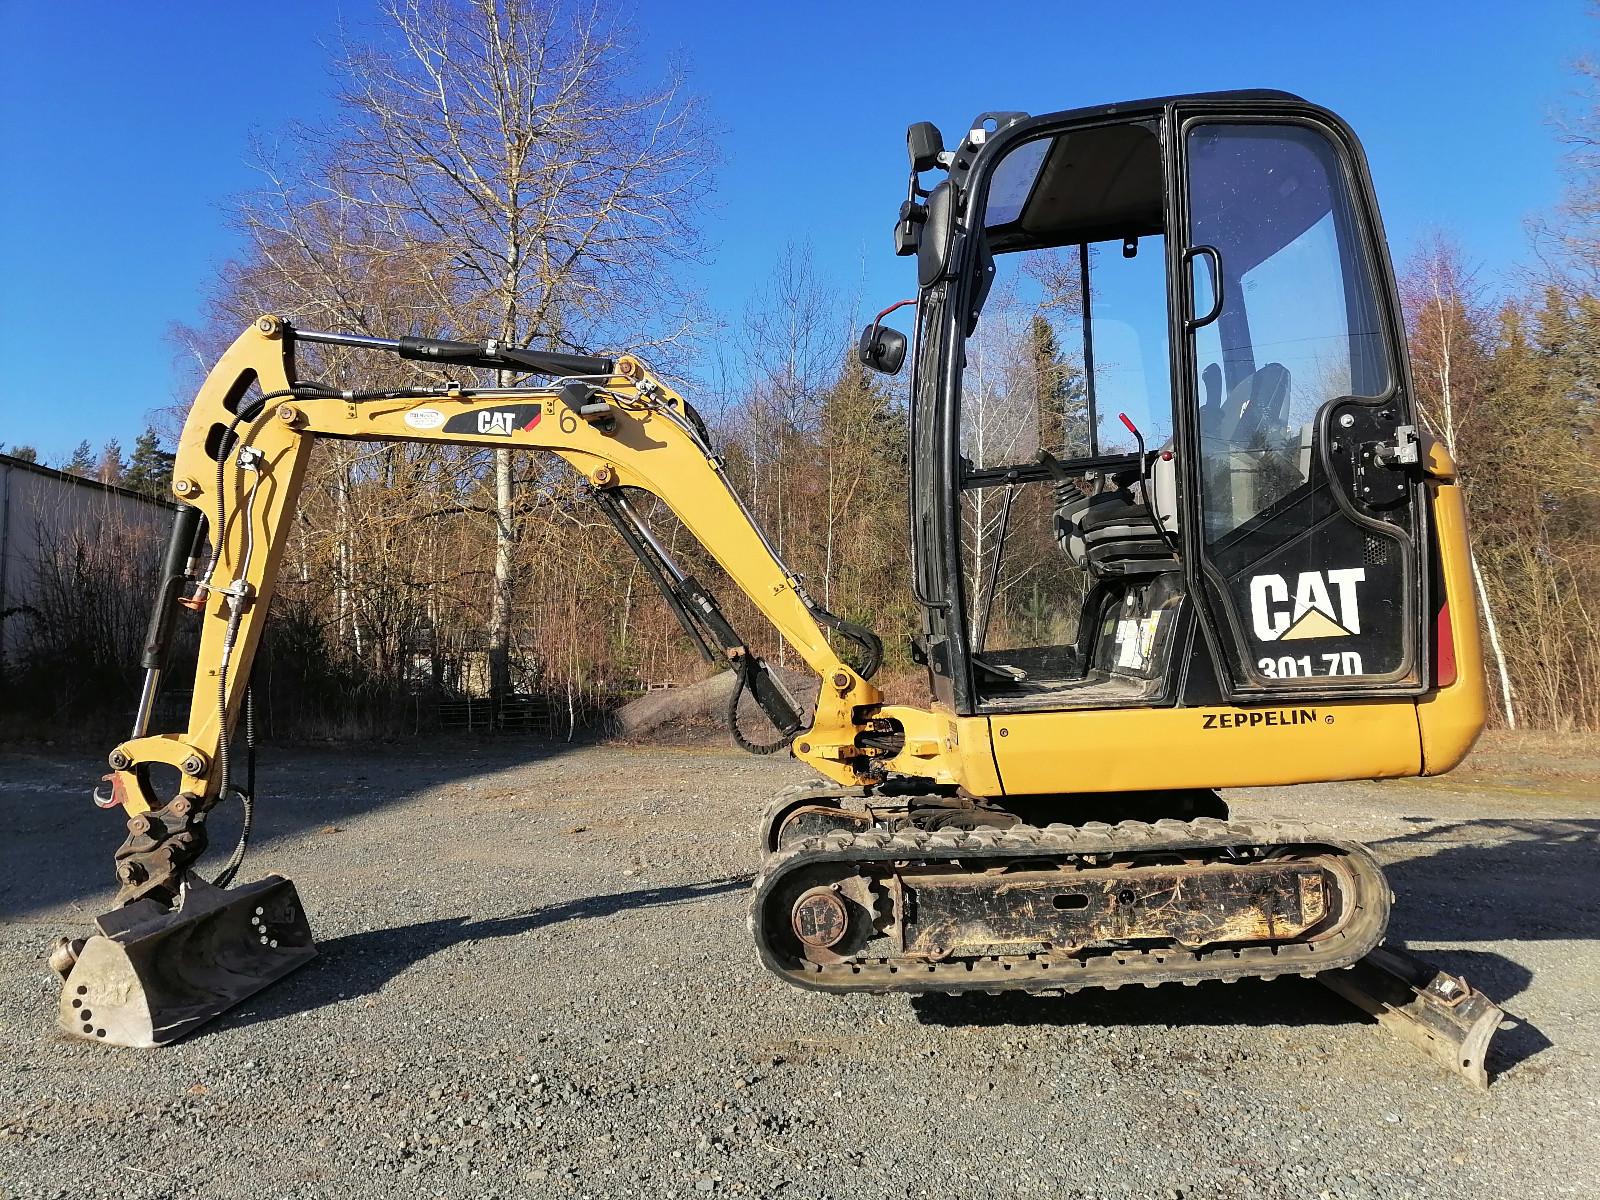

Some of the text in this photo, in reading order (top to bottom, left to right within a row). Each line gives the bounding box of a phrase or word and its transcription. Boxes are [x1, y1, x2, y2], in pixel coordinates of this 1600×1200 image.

[477, 411, 516, 435] CAT
[560, 407, 577, 433] 6
[1250, 568, 1366, 642] CAT
[1202, 709, 1317, 730] ZEPPELIN
